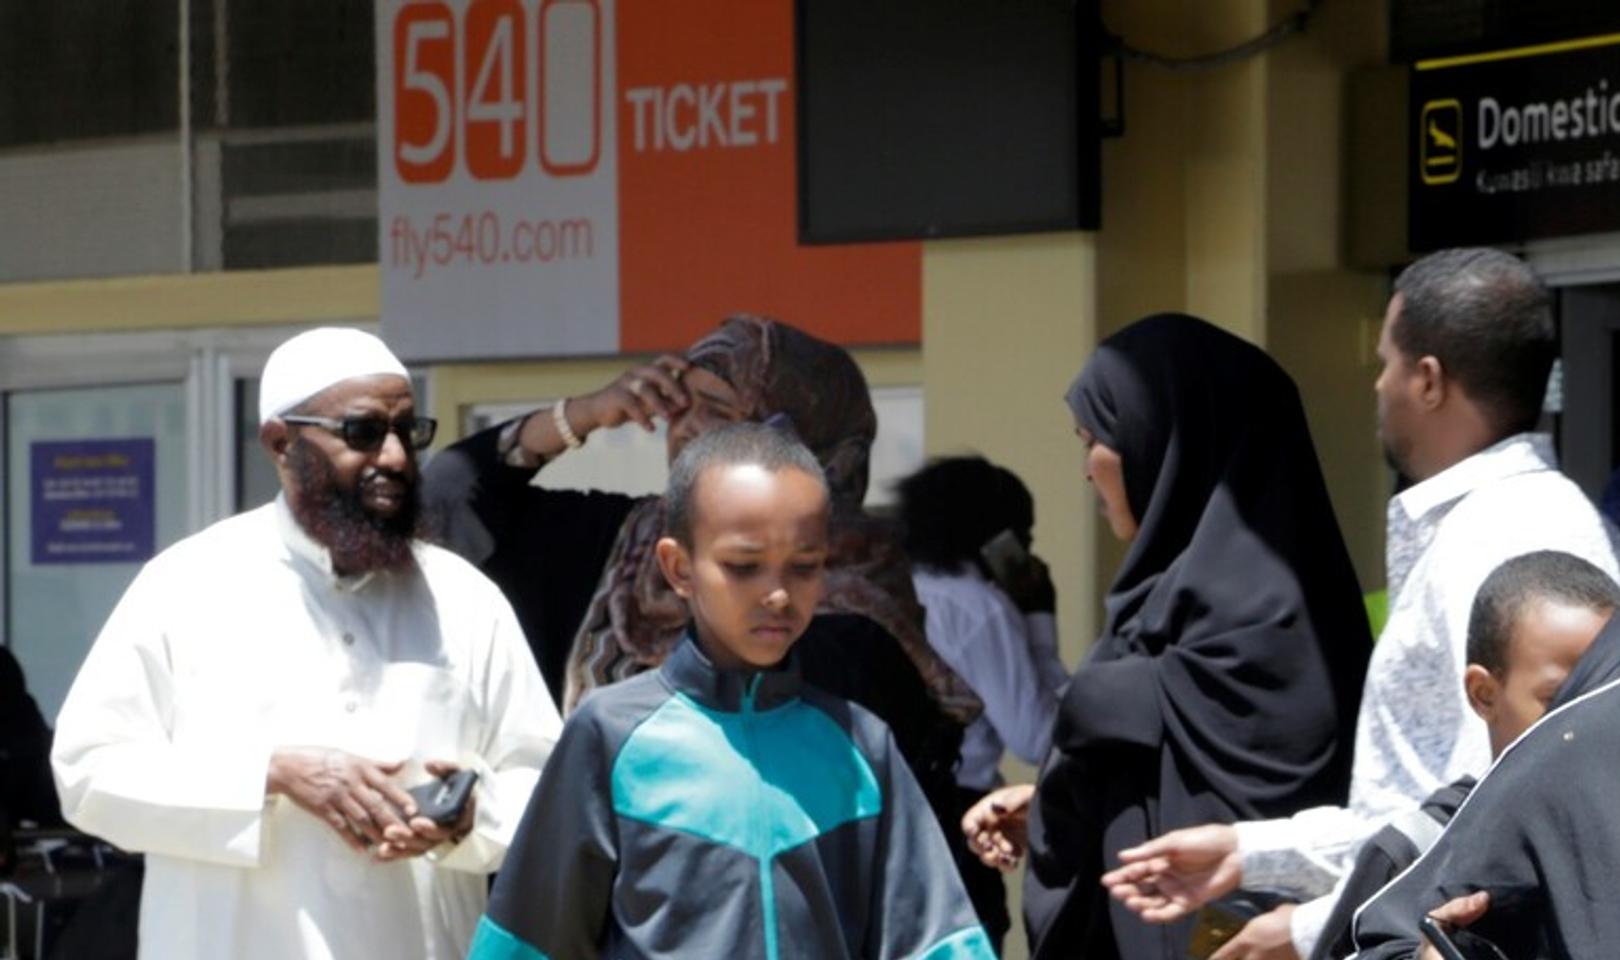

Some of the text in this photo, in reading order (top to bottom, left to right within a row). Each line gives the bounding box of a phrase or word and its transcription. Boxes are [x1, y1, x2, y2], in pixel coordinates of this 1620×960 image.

[394, 0, 600, 184] 540
[626, 79, 788, 152] TICKET
[389, 211, 595, 279] fly540.com
